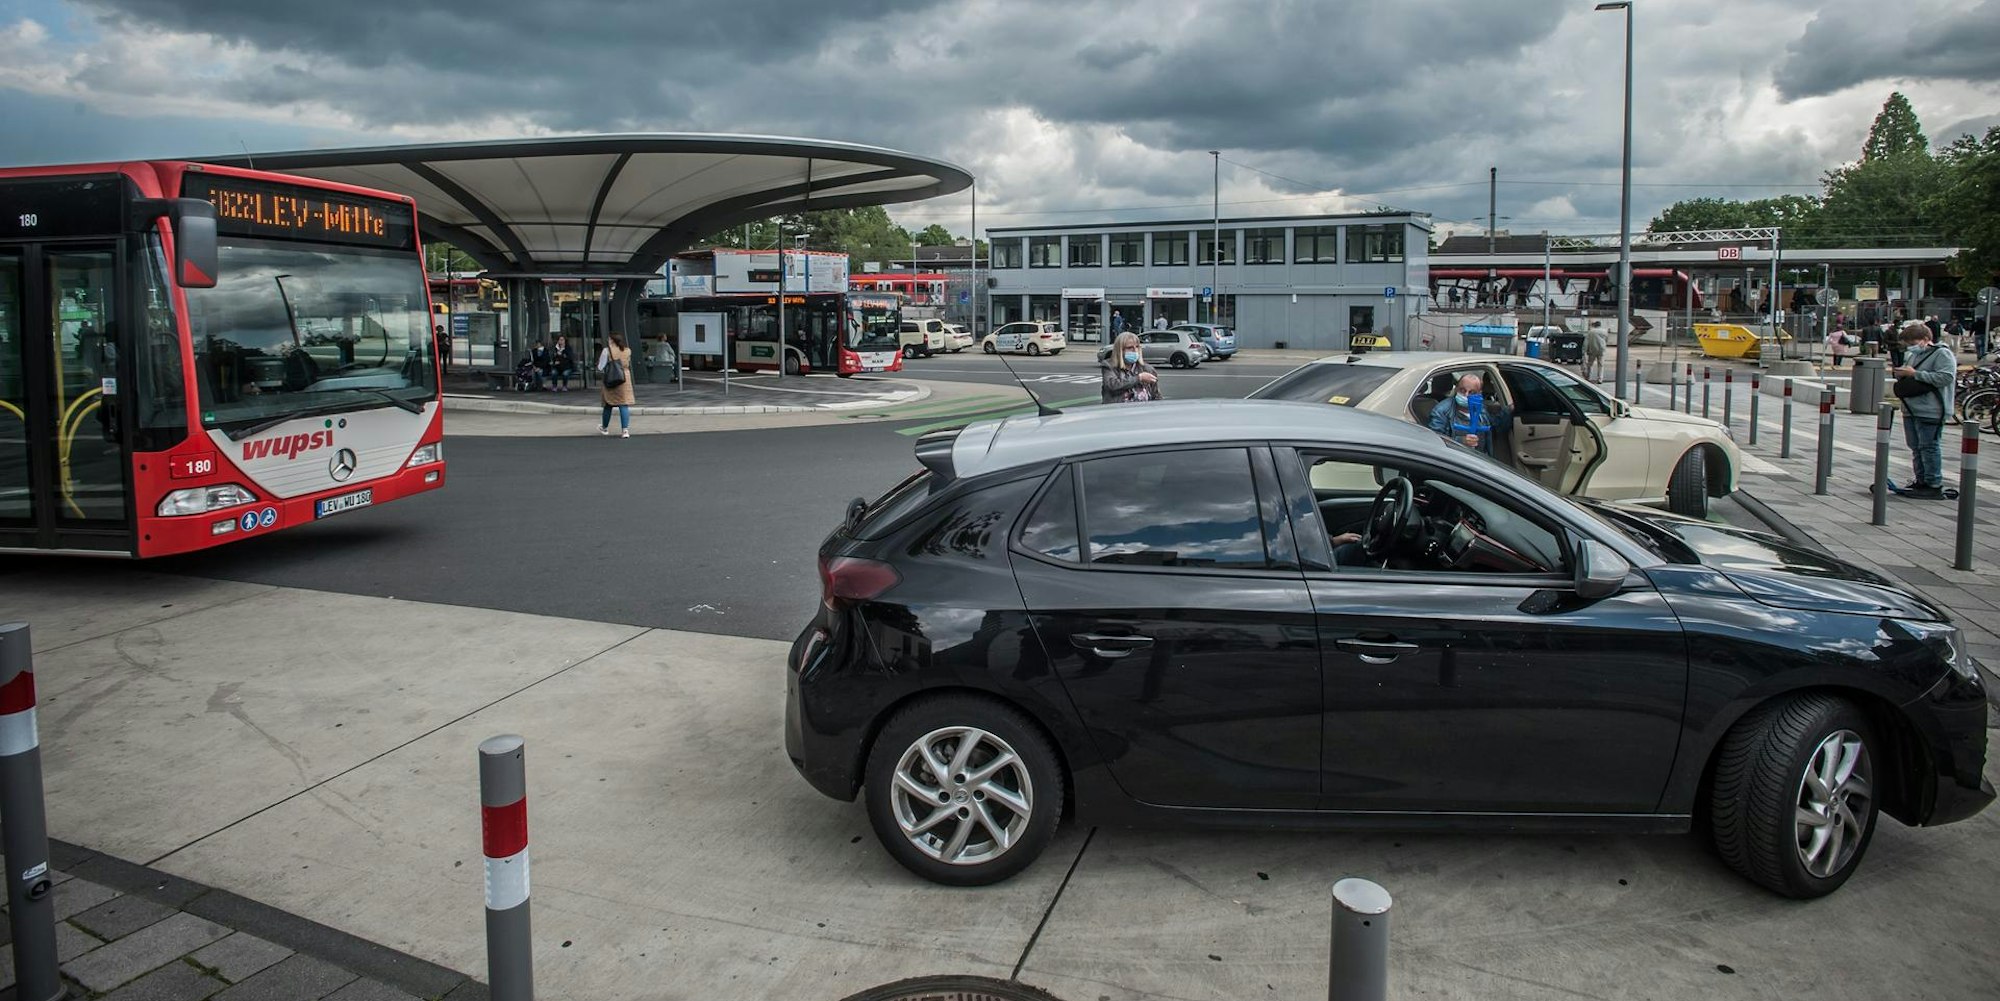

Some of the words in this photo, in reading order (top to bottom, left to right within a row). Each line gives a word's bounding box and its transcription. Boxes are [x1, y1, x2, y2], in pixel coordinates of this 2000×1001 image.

[19, 214, 38, 227] 180
[1721, 249, 1737, 258] DB
[1357, 337, 1375, 345] TAXI
[243, 418, 333, 461] wupsi
[185, 459, 211, 474] 180
[322, 499, 339, 513] LEV
[344, 496, 355, 508] WU
[356, 491, 371, 505] 180
